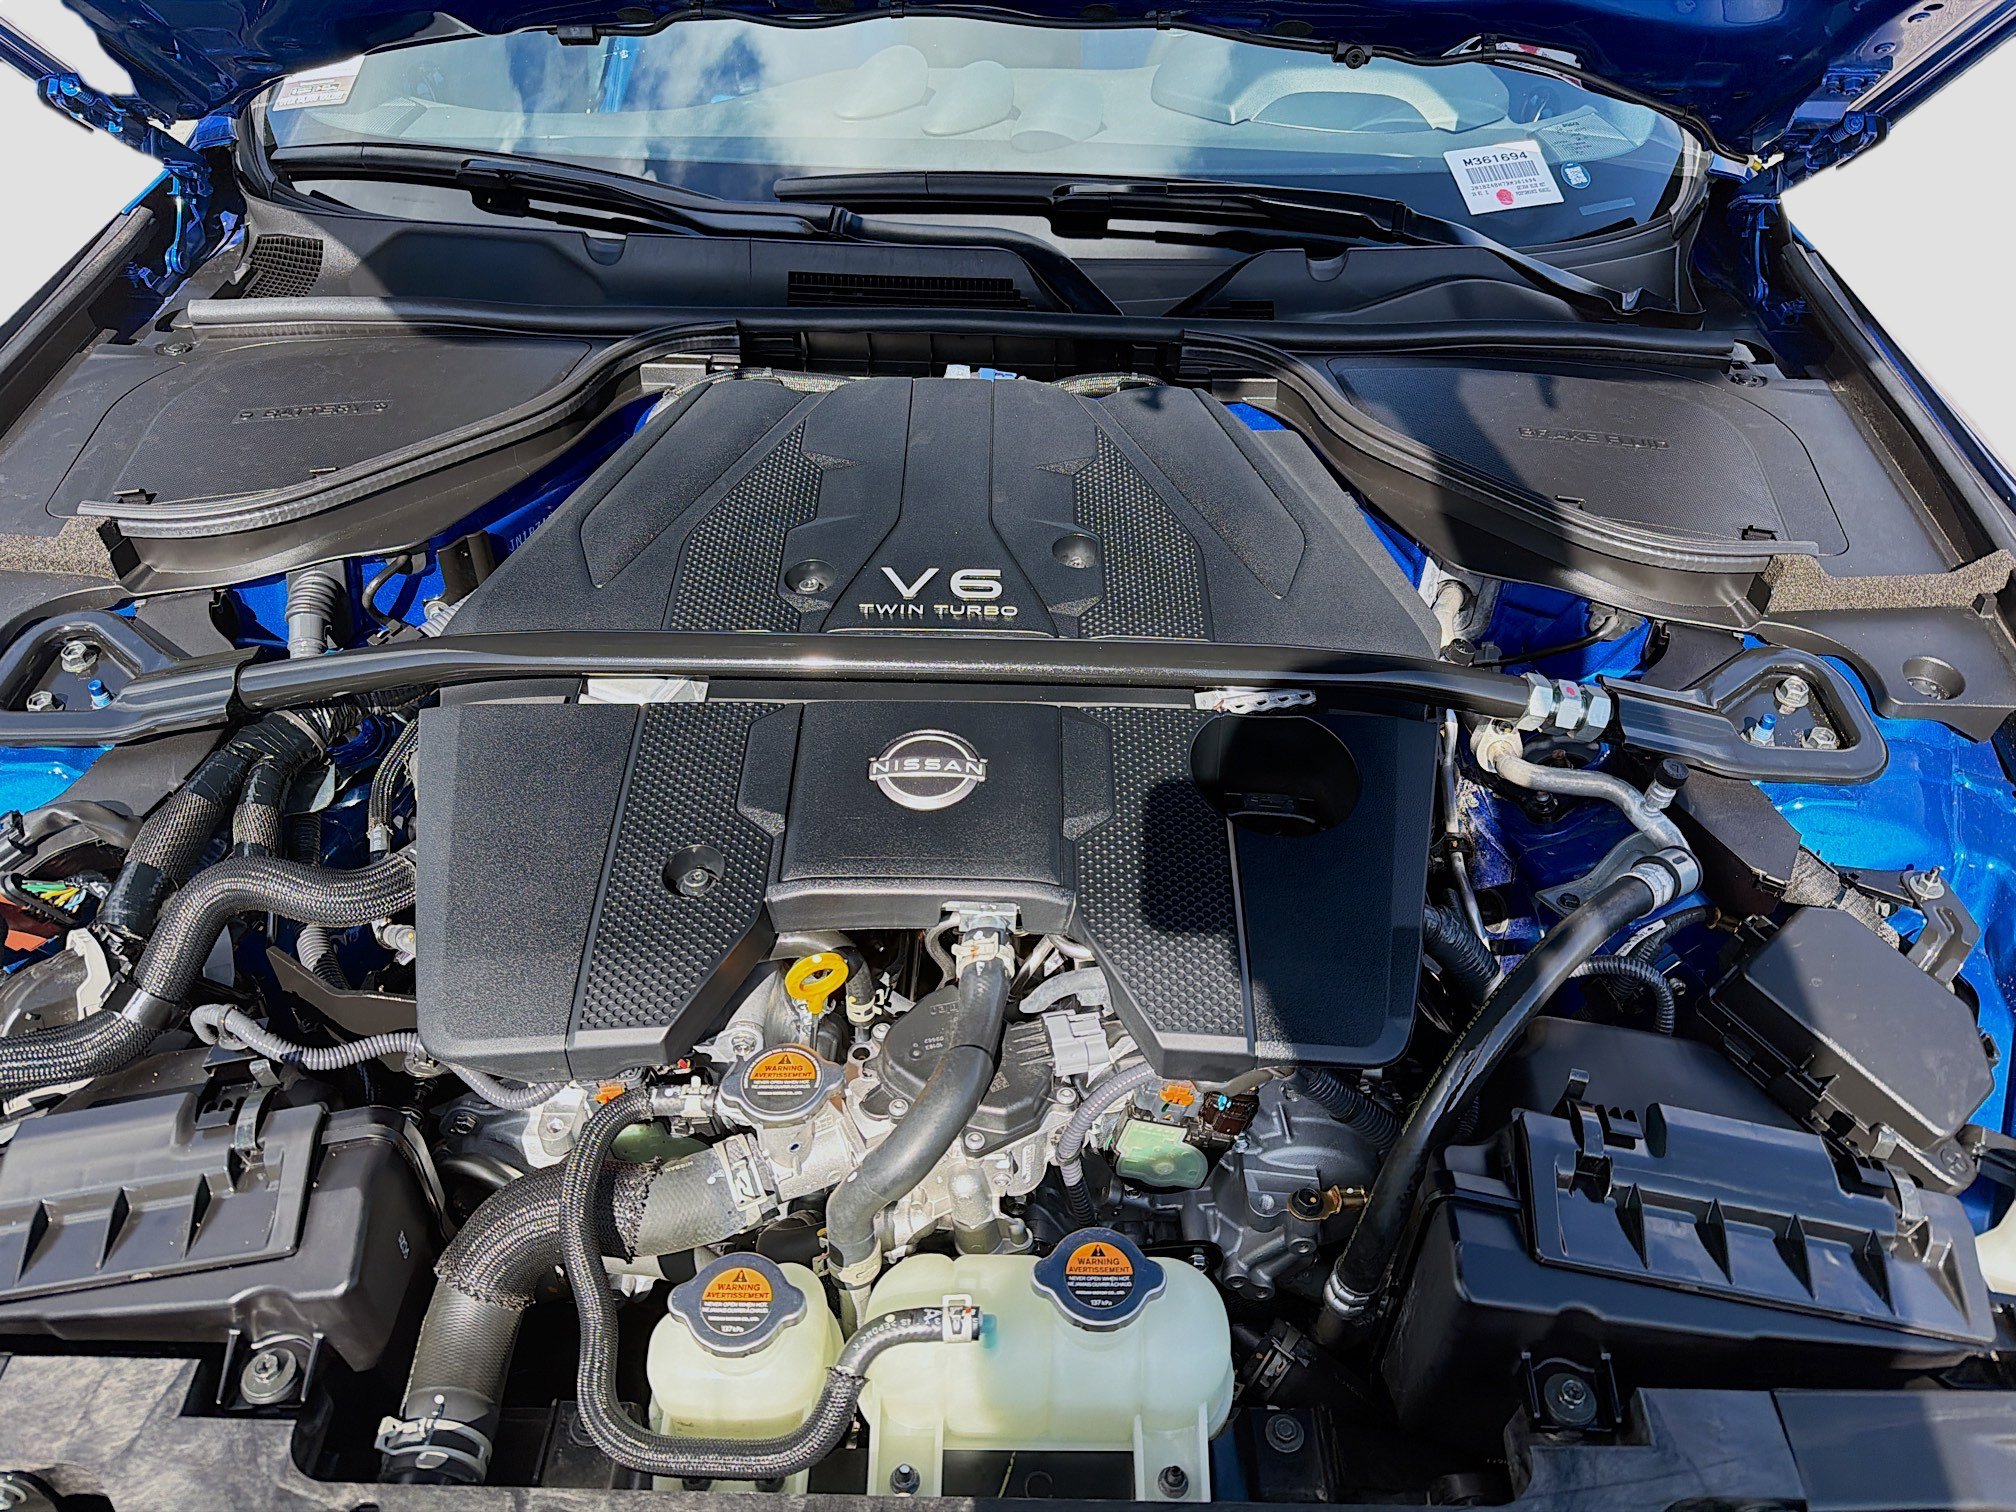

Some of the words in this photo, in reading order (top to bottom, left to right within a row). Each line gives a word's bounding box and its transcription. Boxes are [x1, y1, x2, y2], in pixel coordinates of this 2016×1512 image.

[1463, 151, 1528, 167] M361694
[1518, 427, 1600, 444] BRAKE
[1604, 434, 1672, 450] FLUID
[881, 566, 1003, 601] V6
[858, 603, 924, 616] TWIN
[933, 603, 1018, 617] TURBO
[872, 758, 983, 775] NISSAN
[1077, 1258, 1120, 1266] WARNING
[717, 1283, 761, 1291] WARNING
